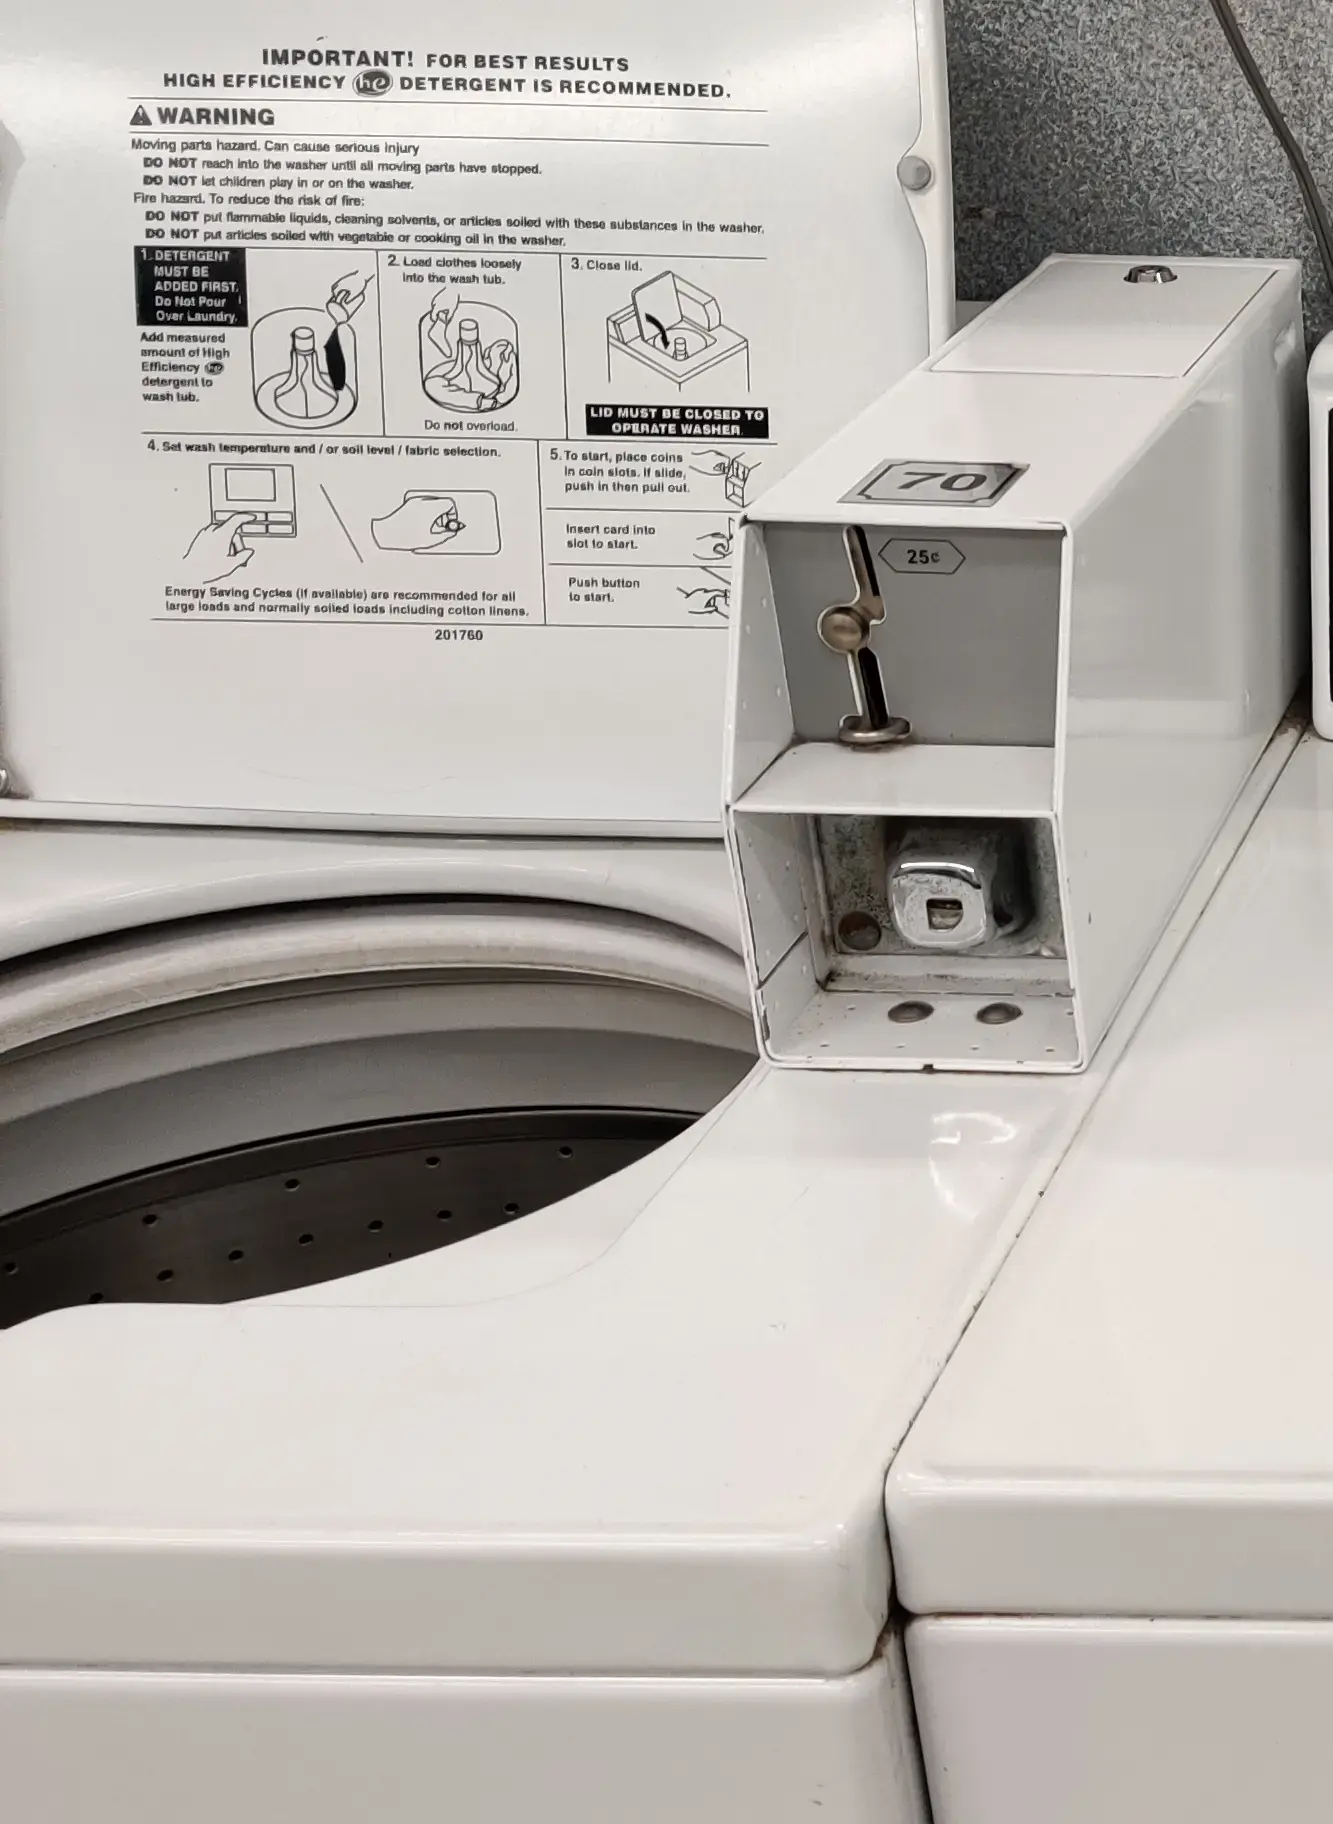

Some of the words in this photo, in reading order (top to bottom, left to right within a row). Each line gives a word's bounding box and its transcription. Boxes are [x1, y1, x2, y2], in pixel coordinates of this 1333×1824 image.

[262, 49, 413, 68] IMPORTANT!
[426, 53, 466, 68] FOR
[474, 54, 527, 69] BEST
[534, 55, 628, 71] RESULTS
[163, 73, 215, 87] HIGH
[222, 74, 345, 89] EFFICIENCY
[356, 72, 390, 94] he
[399, 76, 526, 92] DETERGENT
[533, 78, 552, 93] IS
[559, 80, 730, 97] RECOMMENDED.
[156, 107, 274, 125] WARNING
[131, 138, 176, 153] Moving
[180, 140, 212, 153] parts
[264, 140, 289, 152] Can
[293, 142, 330, 152] cause
[334, 143, 380, 153] serious
[143, 156, 163, 168] DO
[168, 157, 197, 168] NOT
[201, 158, 233, 169] reach
[263, 159, 281, 170] the
[285, 159, 328, 170] washer
[331, 160, 356, 171] until
[360, 160, 373, 171] all
[377, 161, 421, 174] moving
[424, 162, 455, 174] parts
[459, 161, 487, 173] have
[142, 174, 163, 186] DO
[168, 175, 197, 186] NOT
[201, 175, 215, 186] let
[219, 175, 265, 187] children
[269, 176, 293, 190] play
[297, 176, 308, 188] in
[311, 179, 324, 188] or
[328, 179, 343, 188] on
[346, 177, 365, 189] the
[154, 249, 229, 261] DETERGENT
[586, 259, 620, 270] Close
[153, 265, 189, 277] MUST
[191, 265, 208, 277] BE
[153, 280, 198, 292] ADDED
[155, 295, 171, 306] Do
[174, 295, 195, 307] Not
[198, 295, 226, 307] Pour
[156, 310, 184, 321] Over
[898, 471, 987, 491] 70
[566, 523, 600, 534] Insert
[603, 524, 629, 535] card
[566, 538, 588, 548] slot
[591, 539, 603, 549] to
[907, 549, 940, 564] 25¢
[434, 629, 483, 640] 201760
